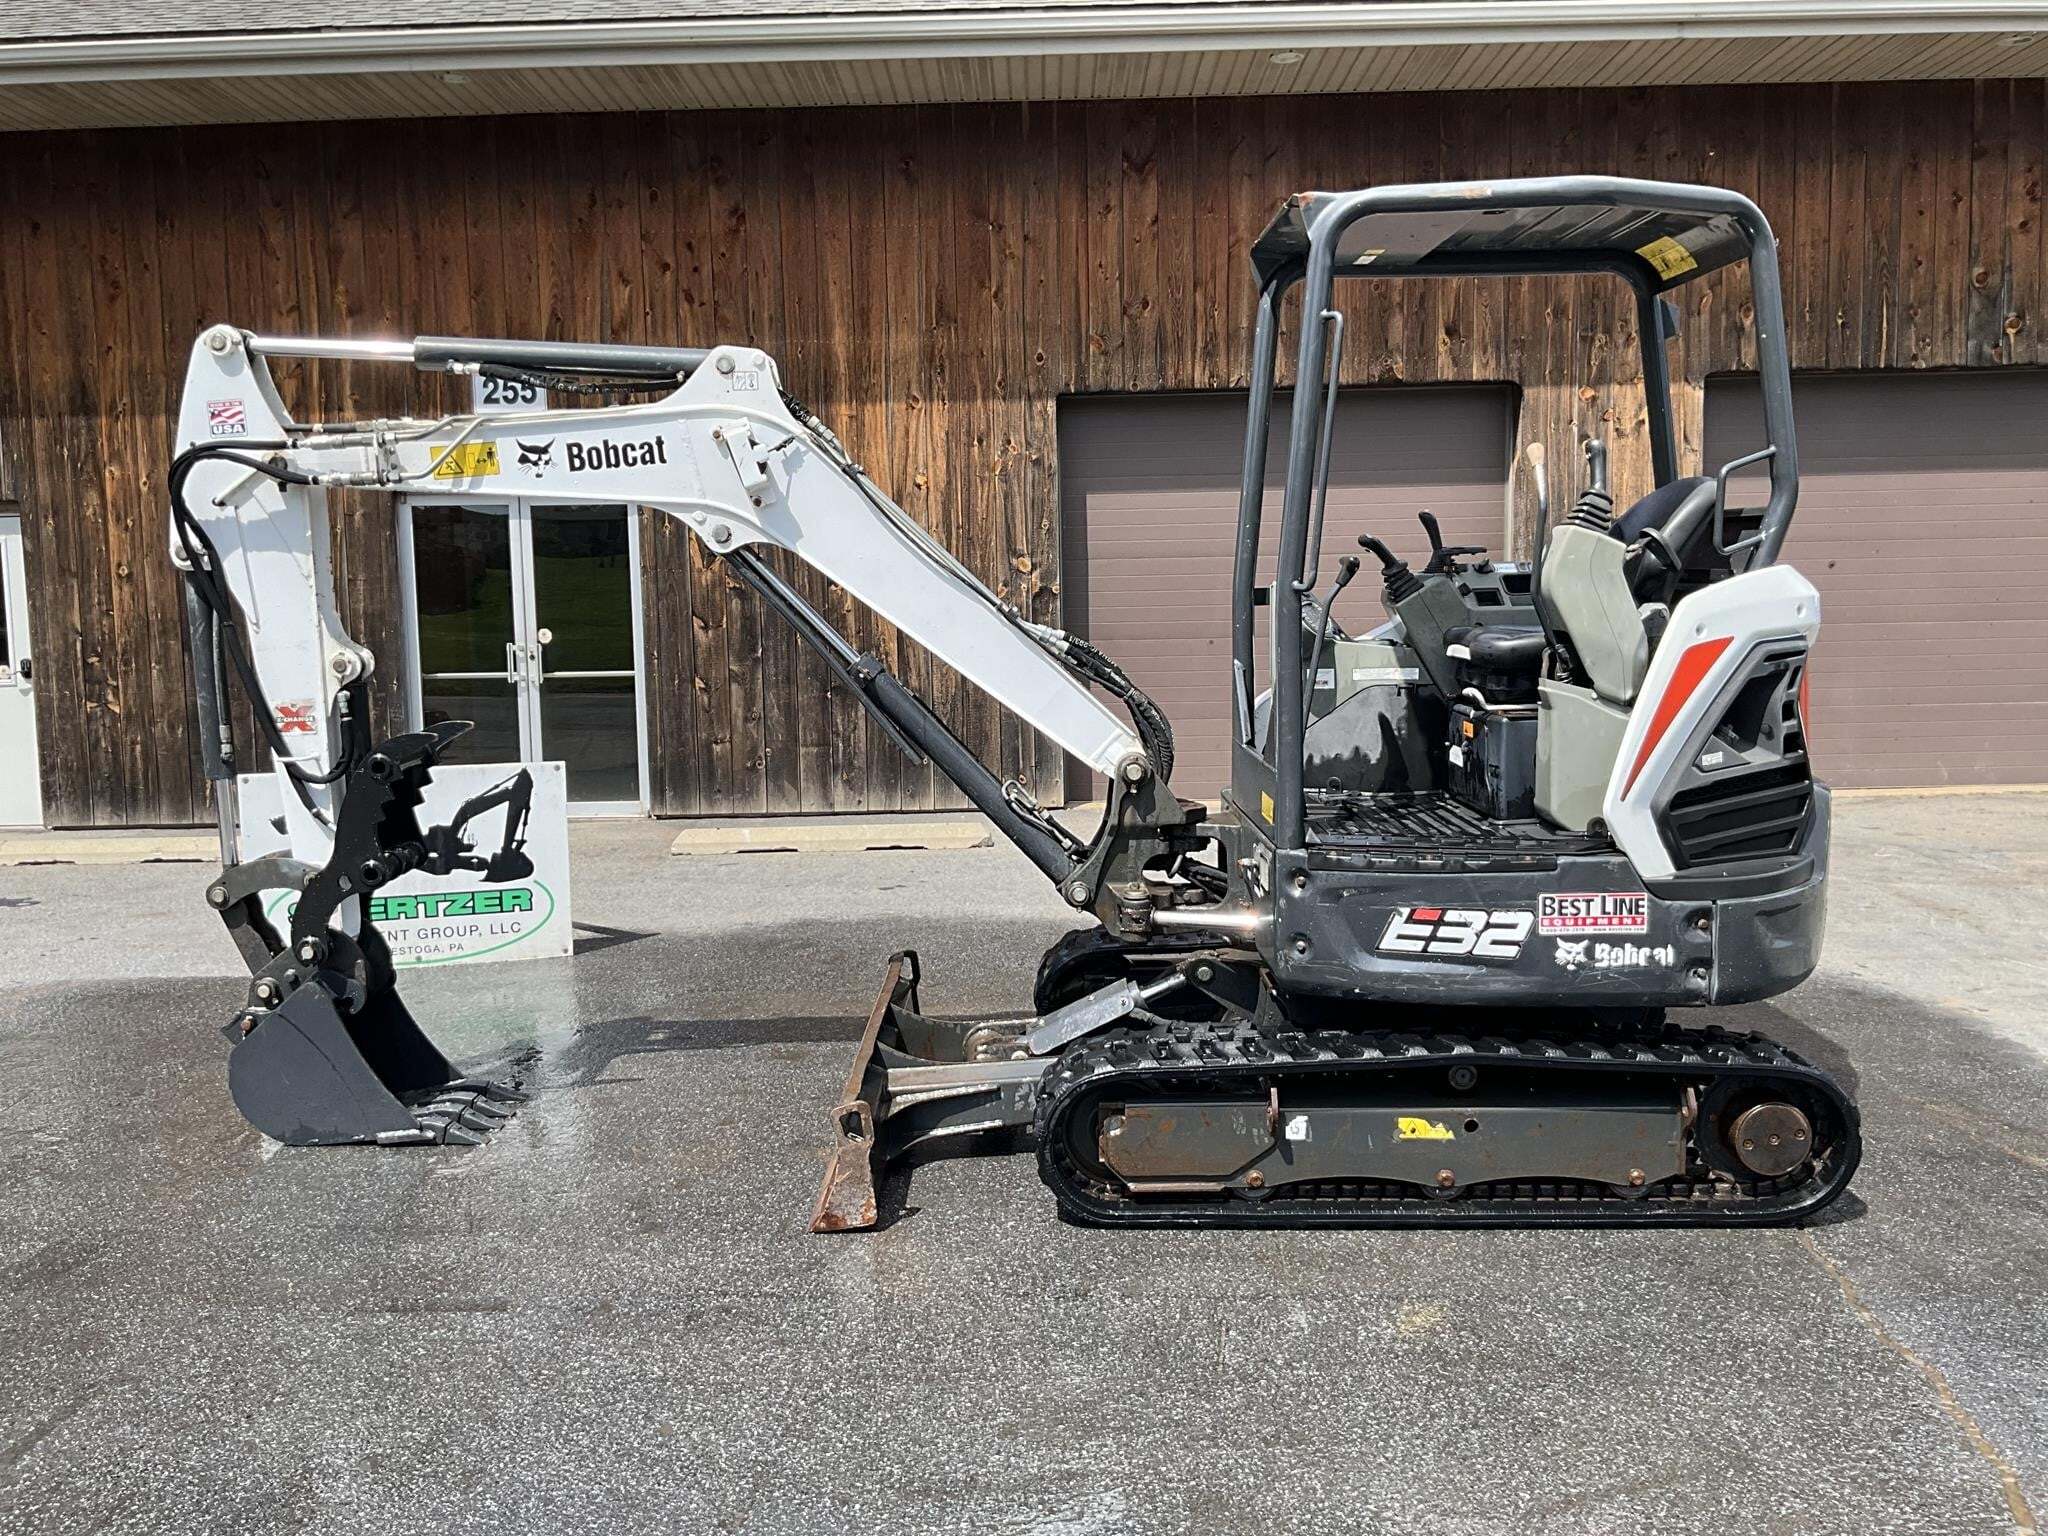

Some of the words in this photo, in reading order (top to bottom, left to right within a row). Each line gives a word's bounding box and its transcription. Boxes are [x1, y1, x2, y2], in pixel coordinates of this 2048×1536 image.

[483, 375, 537, 405] 255
[212, 424, 245, 434] USA
[566, 435, 668, 472] Bobcat
[370, 888, 533, 921] ERTZER
[1542, 896, 1595, 916] BEST
[1601, 895, 1645, 915] LINE
[416, 924, 482, 940] GROUP,
[489, 921, 521, 935] LLC
[1378, 906, 1536, 959] E32
[1541, 917, 1645, 927] EQUIPMENT
[391, 944, 445, 956] ESTOGA,
[449, 943, 464, 953] PA
[1594, 942, 1674, 967] Bobcat
